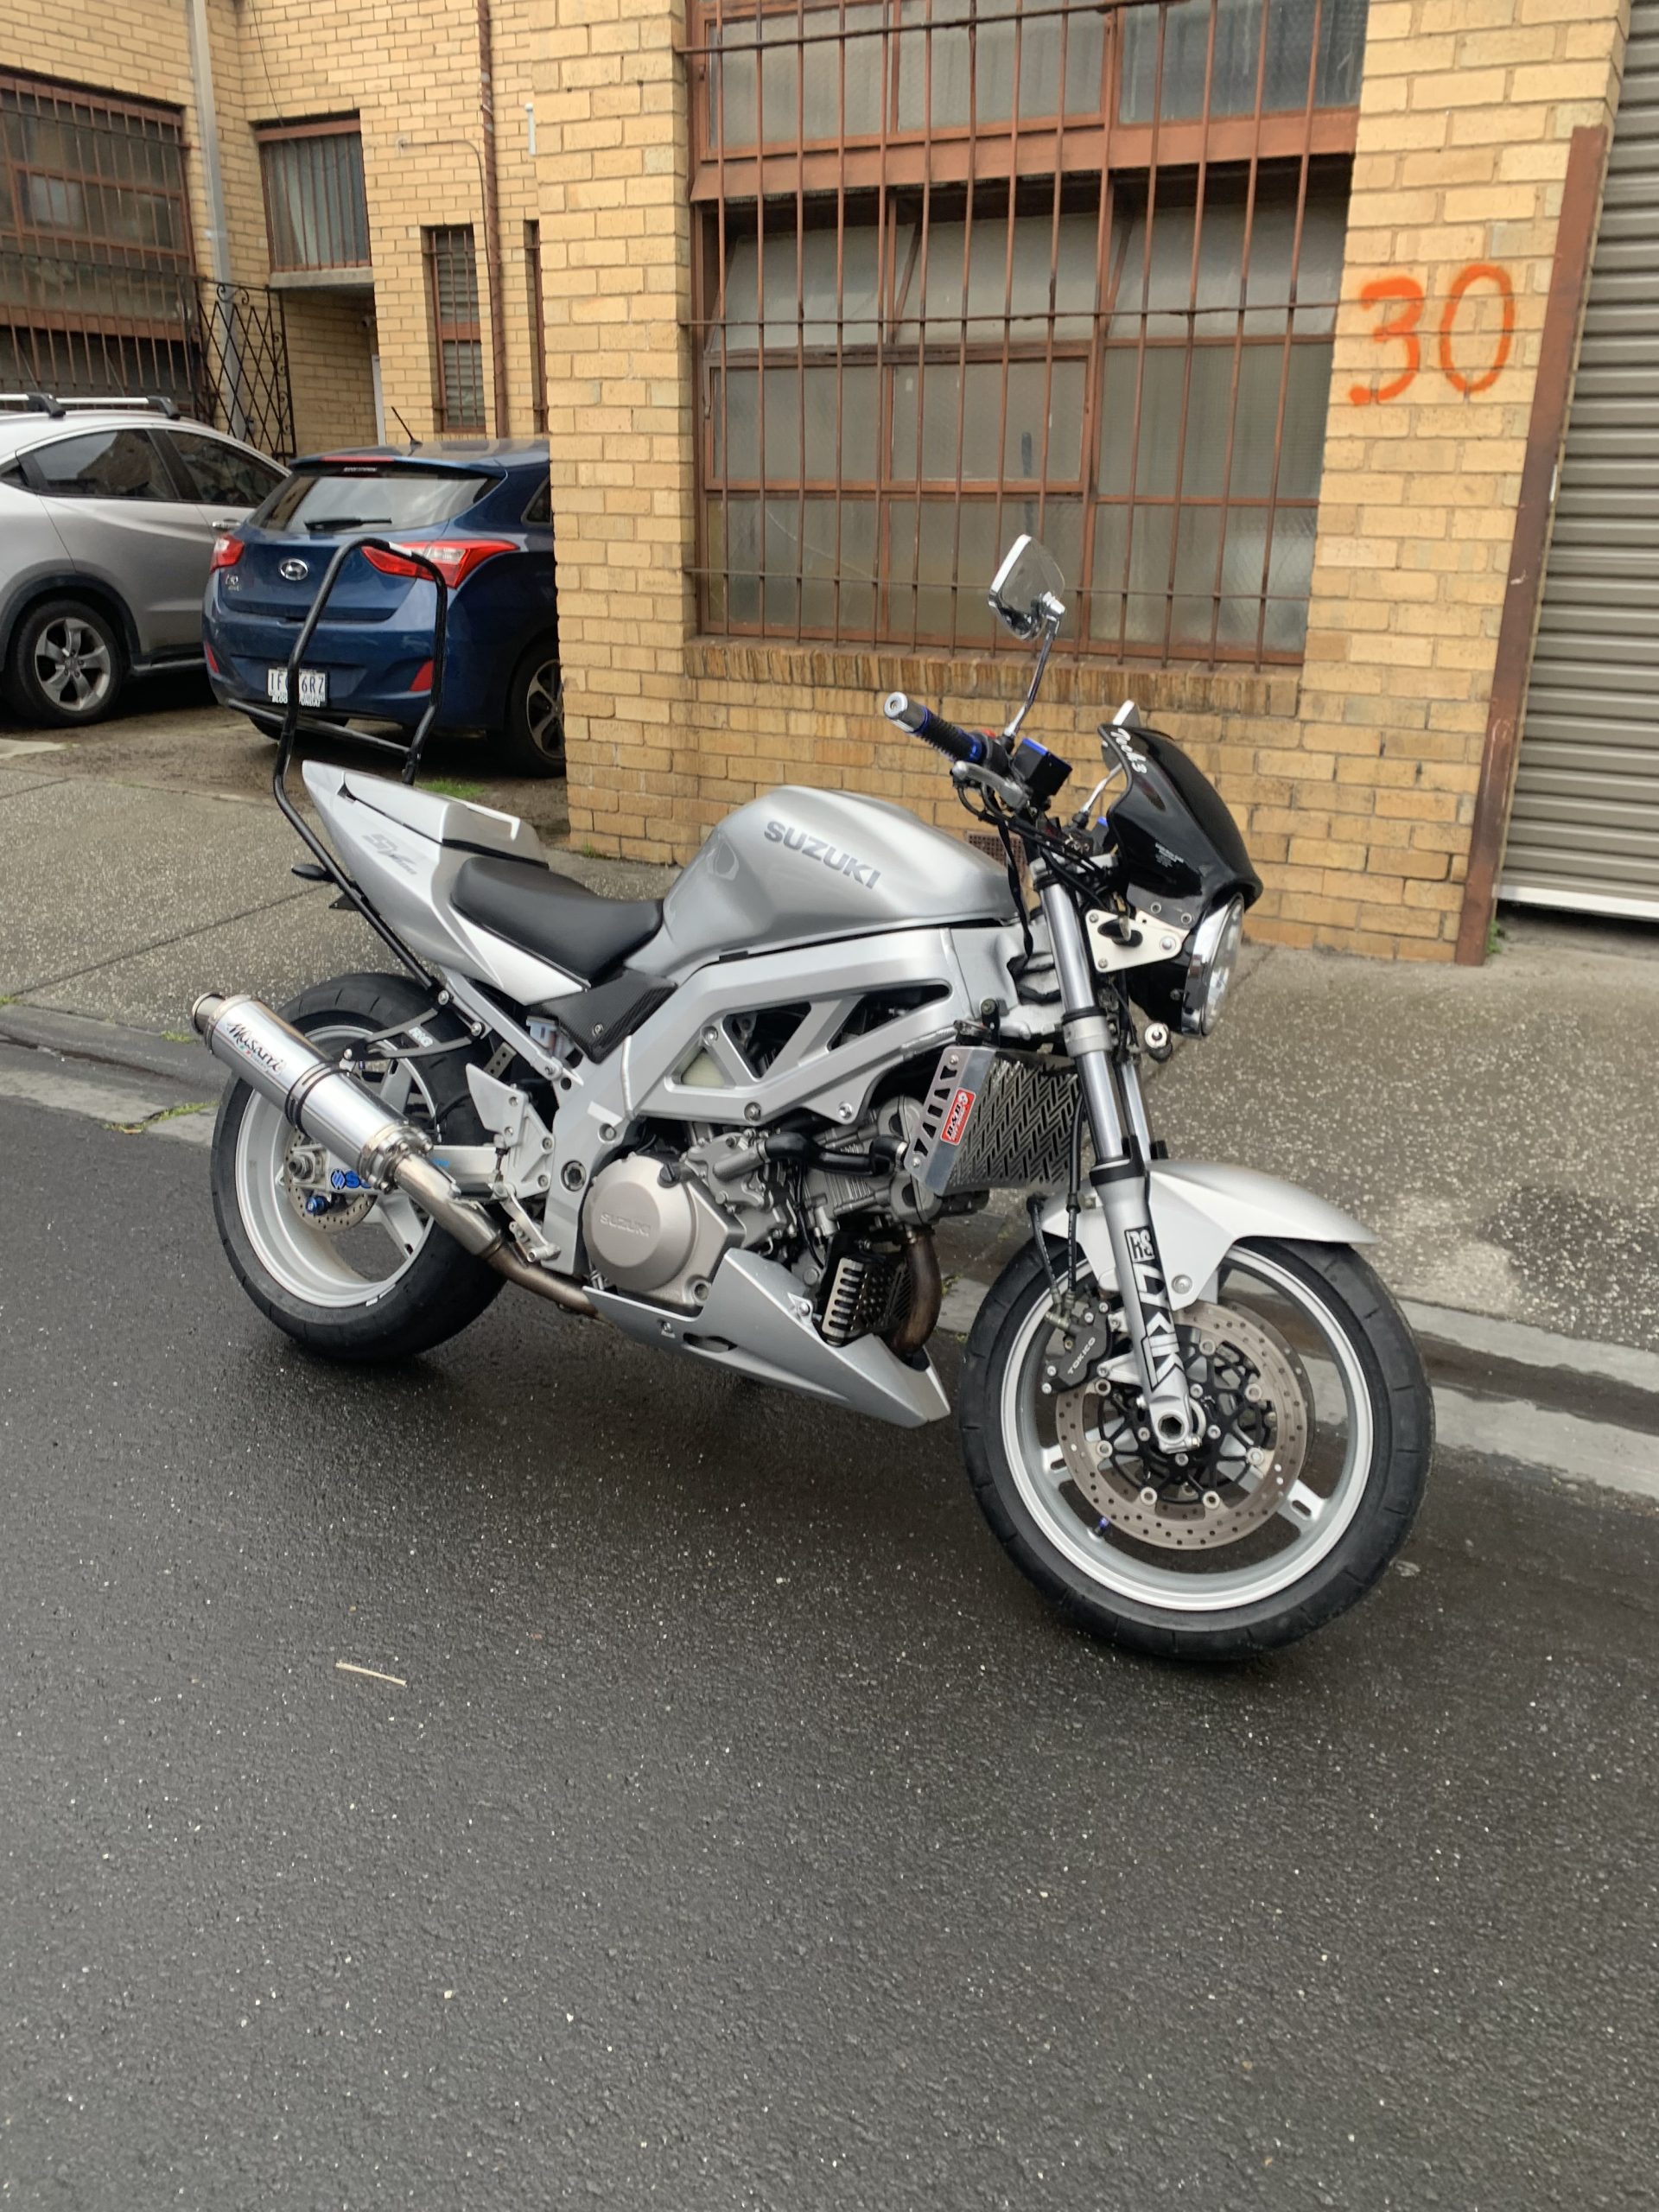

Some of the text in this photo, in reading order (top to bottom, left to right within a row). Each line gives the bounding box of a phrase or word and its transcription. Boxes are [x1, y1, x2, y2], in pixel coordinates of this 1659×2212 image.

[1349, 263, 1515, 406] 30
[764, 820, 881, 889] SUZUKI
[599, 1211, 652, 1237] SUZUKI
[1067, 1337, 1096, 1375] TOKICO
